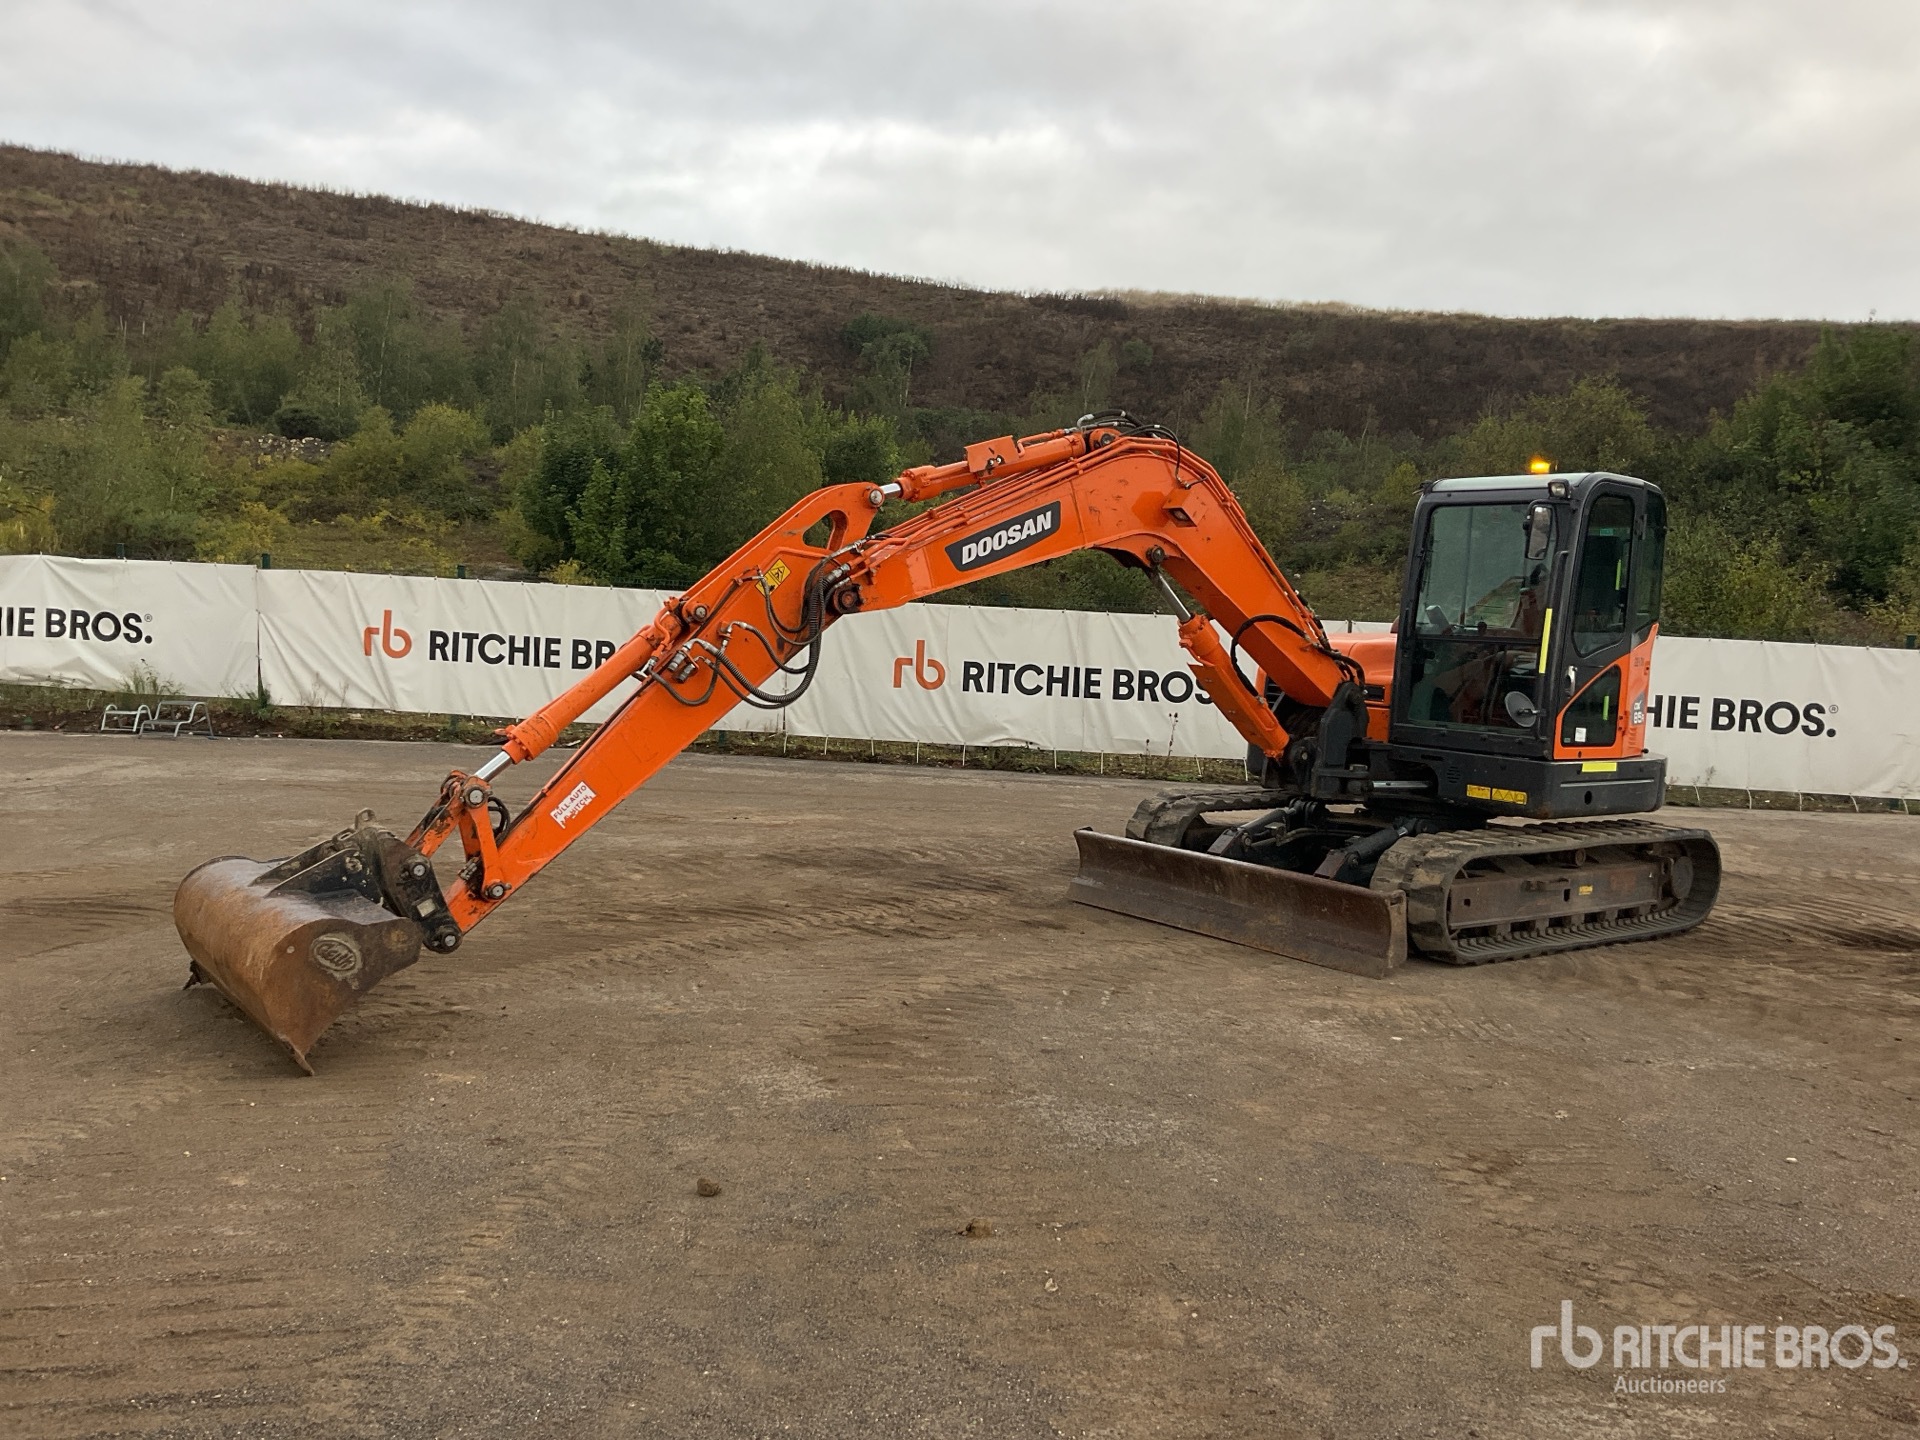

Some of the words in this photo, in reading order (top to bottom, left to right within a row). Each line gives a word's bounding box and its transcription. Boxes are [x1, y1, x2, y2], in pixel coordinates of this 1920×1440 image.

[962, 511, 1052, 565] DOOSAN
[45, 608, 152, 644] BROS.
[364, 609, 412, 659] rb
[429, 630, 561, 669] RITCHIE
[893, 640, 946, 690] rb
[962, 661, 1102, 699] RITCHIE
[1711, 697, 1836, 738] BROS.
